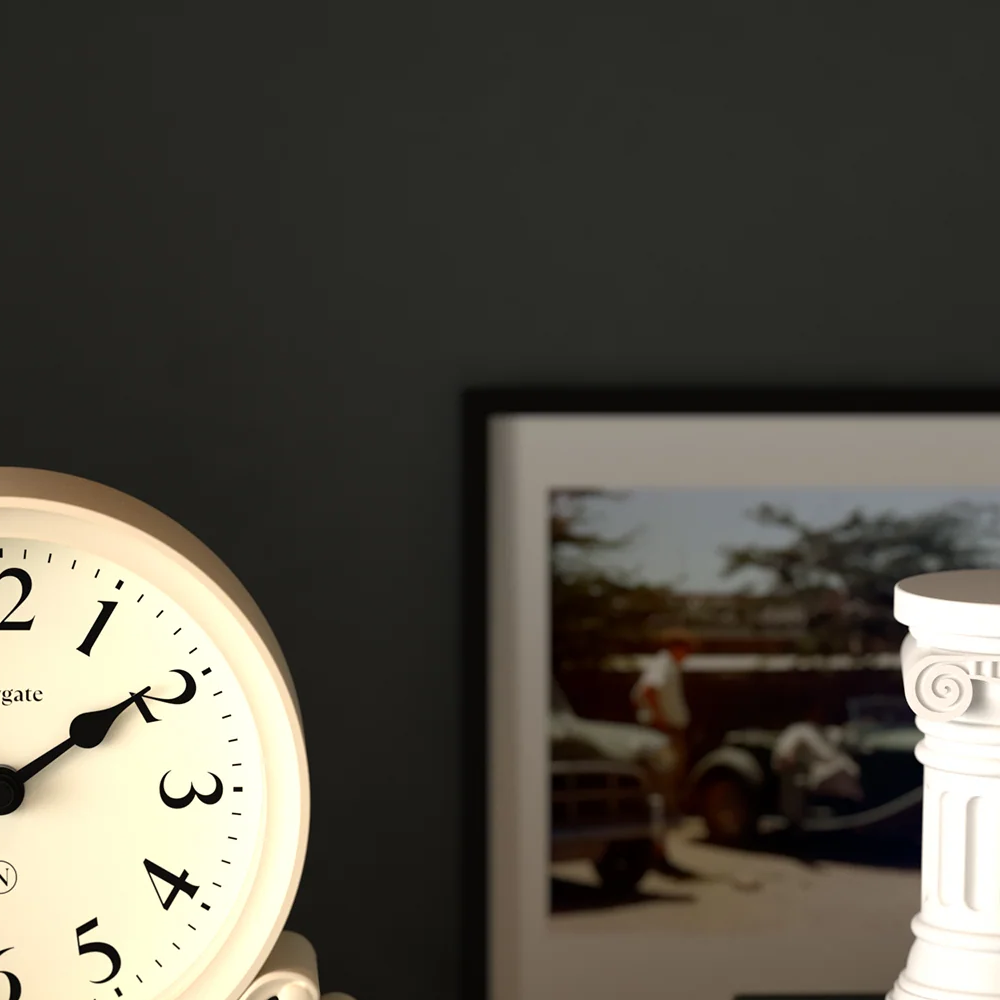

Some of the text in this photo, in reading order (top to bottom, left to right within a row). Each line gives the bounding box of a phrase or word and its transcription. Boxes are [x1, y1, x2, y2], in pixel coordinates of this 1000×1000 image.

[76, 600, 119, 657] 1
[128, 668, 197, 723] 2
[159, 769, 224, 810] 3
[142, 858, 200, 911] 4
[75, 917, 122, 984] 5
